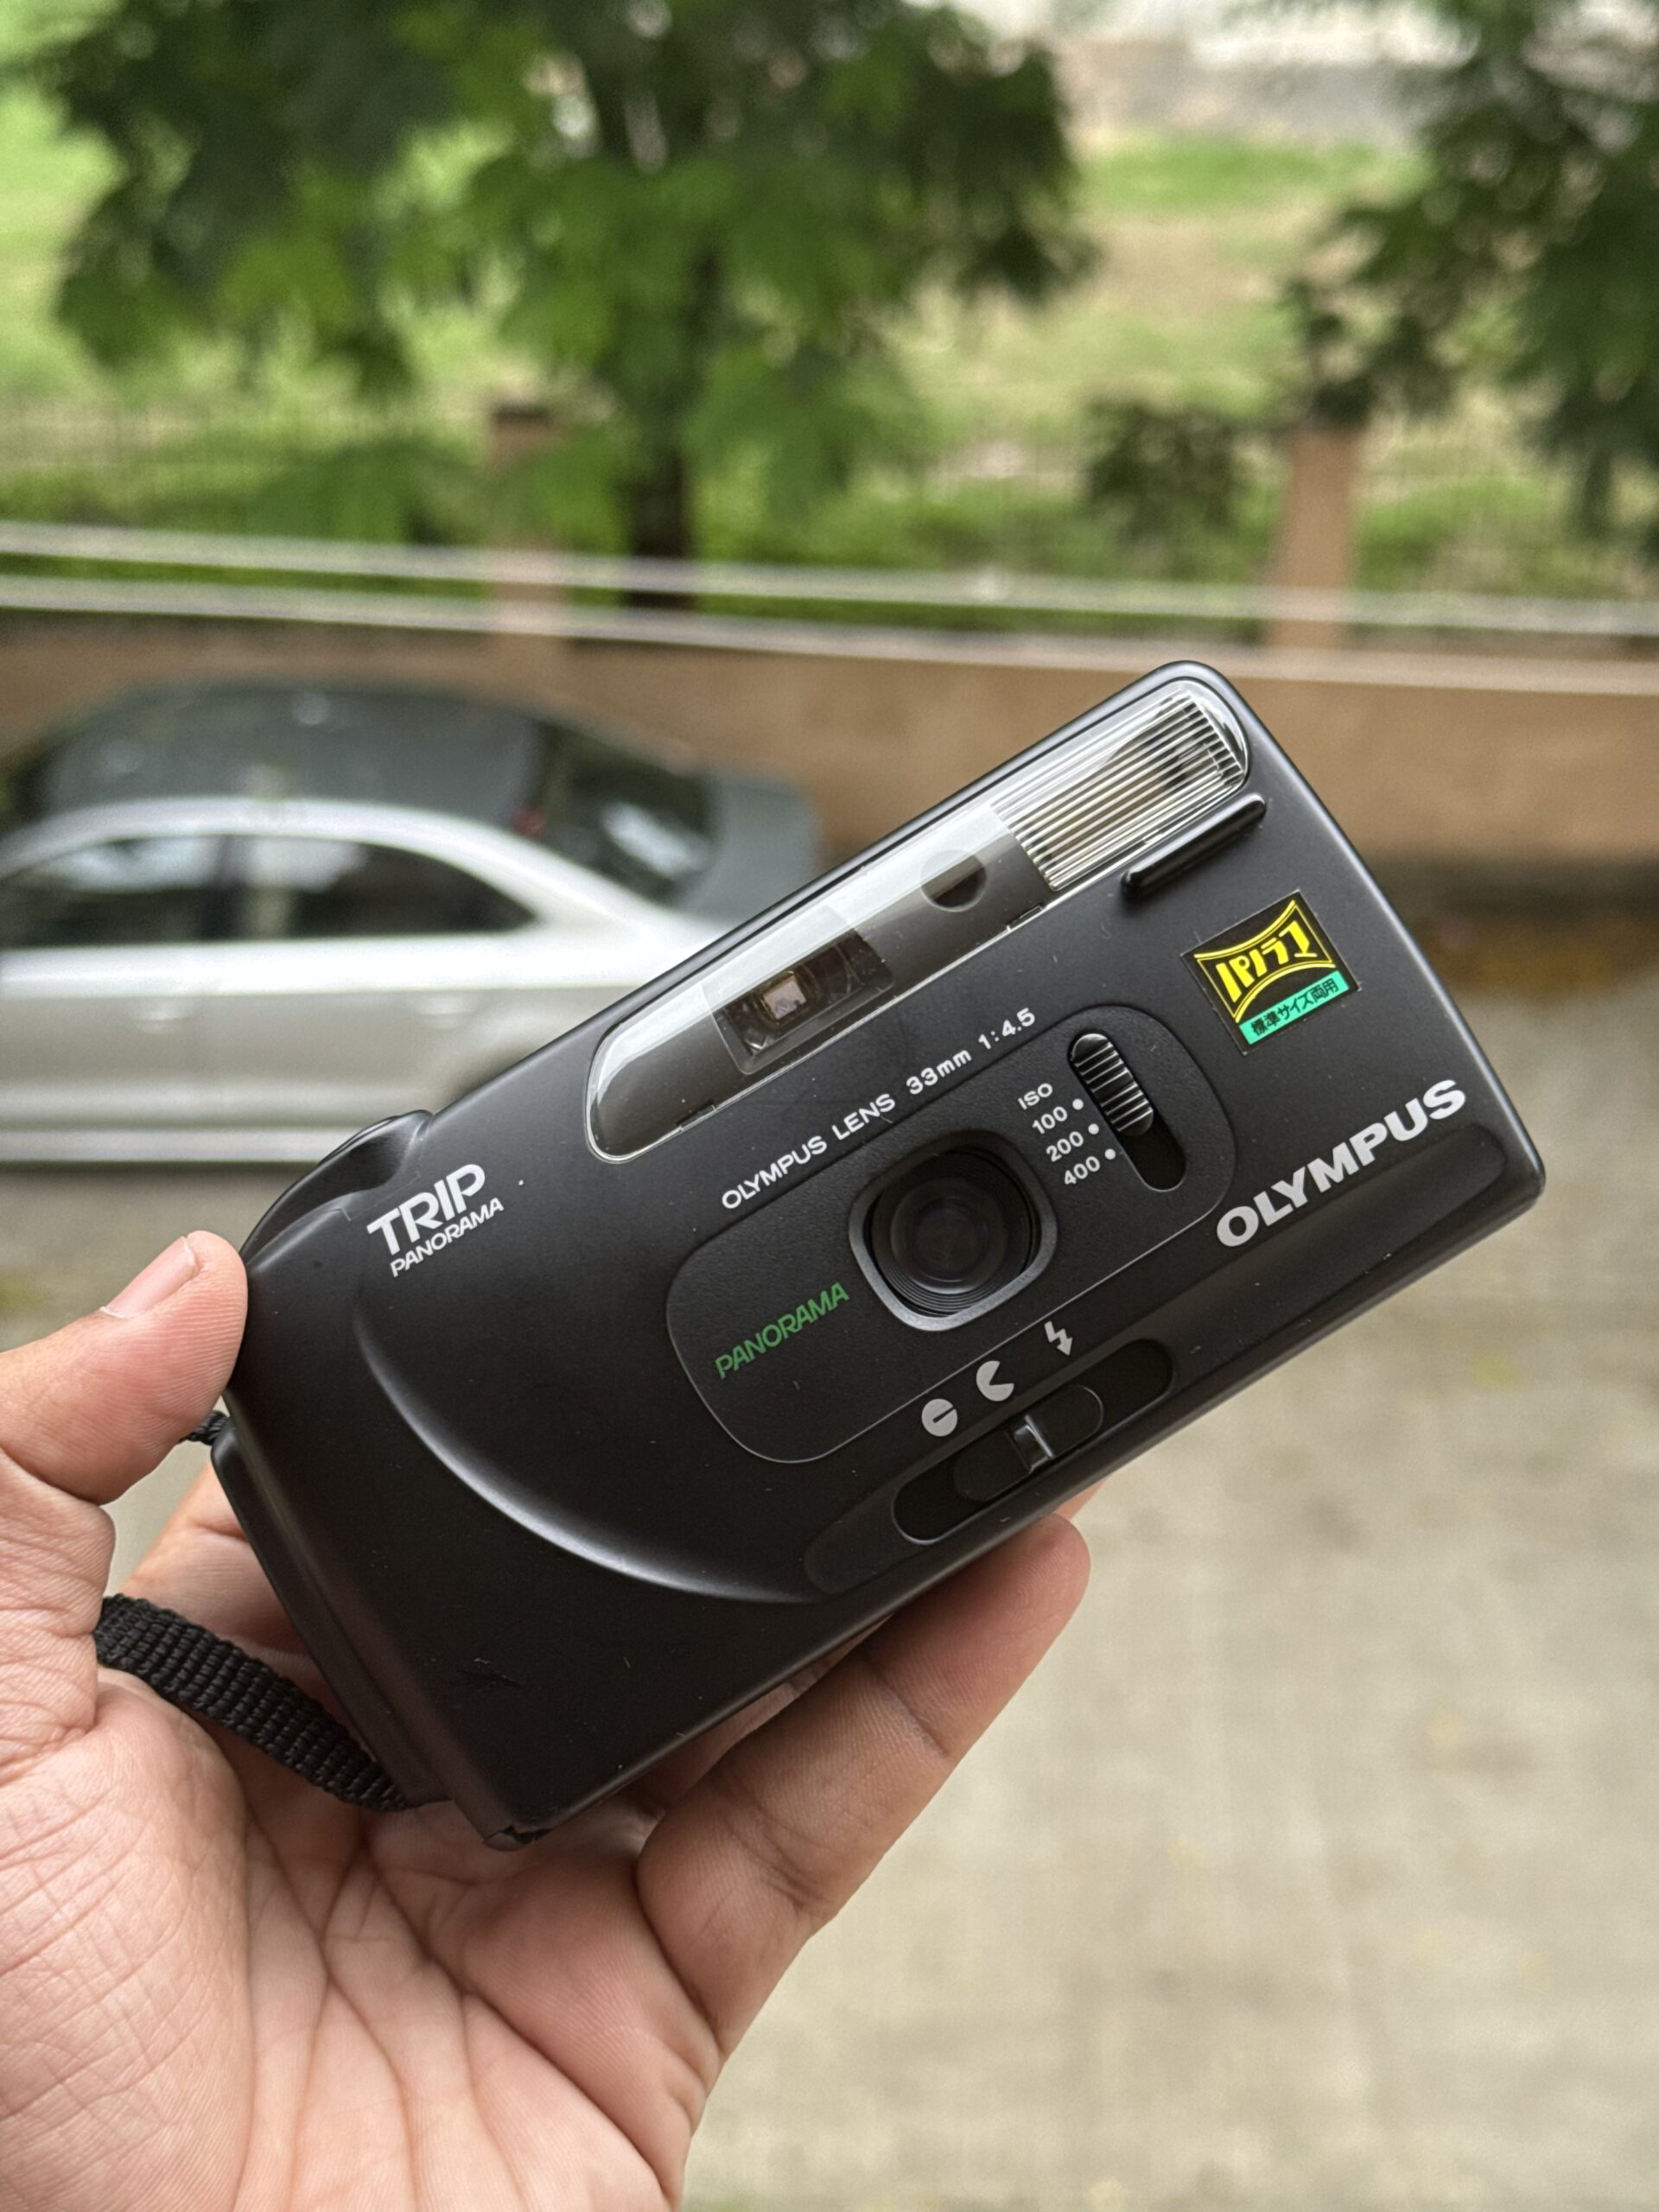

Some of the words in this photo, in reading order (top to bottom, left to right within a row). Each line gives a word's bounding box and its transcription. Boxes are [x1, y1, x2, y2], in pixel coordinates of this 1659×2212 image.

[1250, 977, 1338, 1036] 標準サイズ両用
[721, 1135, 828, 1211] OLYMPUS
[831, 1093, 896, 1141] LENS
[906, 1050, 972, 1096] 33mm
[977, 1007, 1037, 1051] 1:4.5
[1017, 1082, 1054, 1110] ISO
[1032, 1106, 1069, 1135] 100
[1046, 1131, 1085, 1162] 200
[1063, 1155, 1101, 1185] 400
[1216, 1079, 1466, 1247] OLYMPUS
[366, 1164, 486, 1255] TRIP
[390, 1198, 504, 1277] PANORAMA
[715, 1282, 850, 1379] PANORAMA
